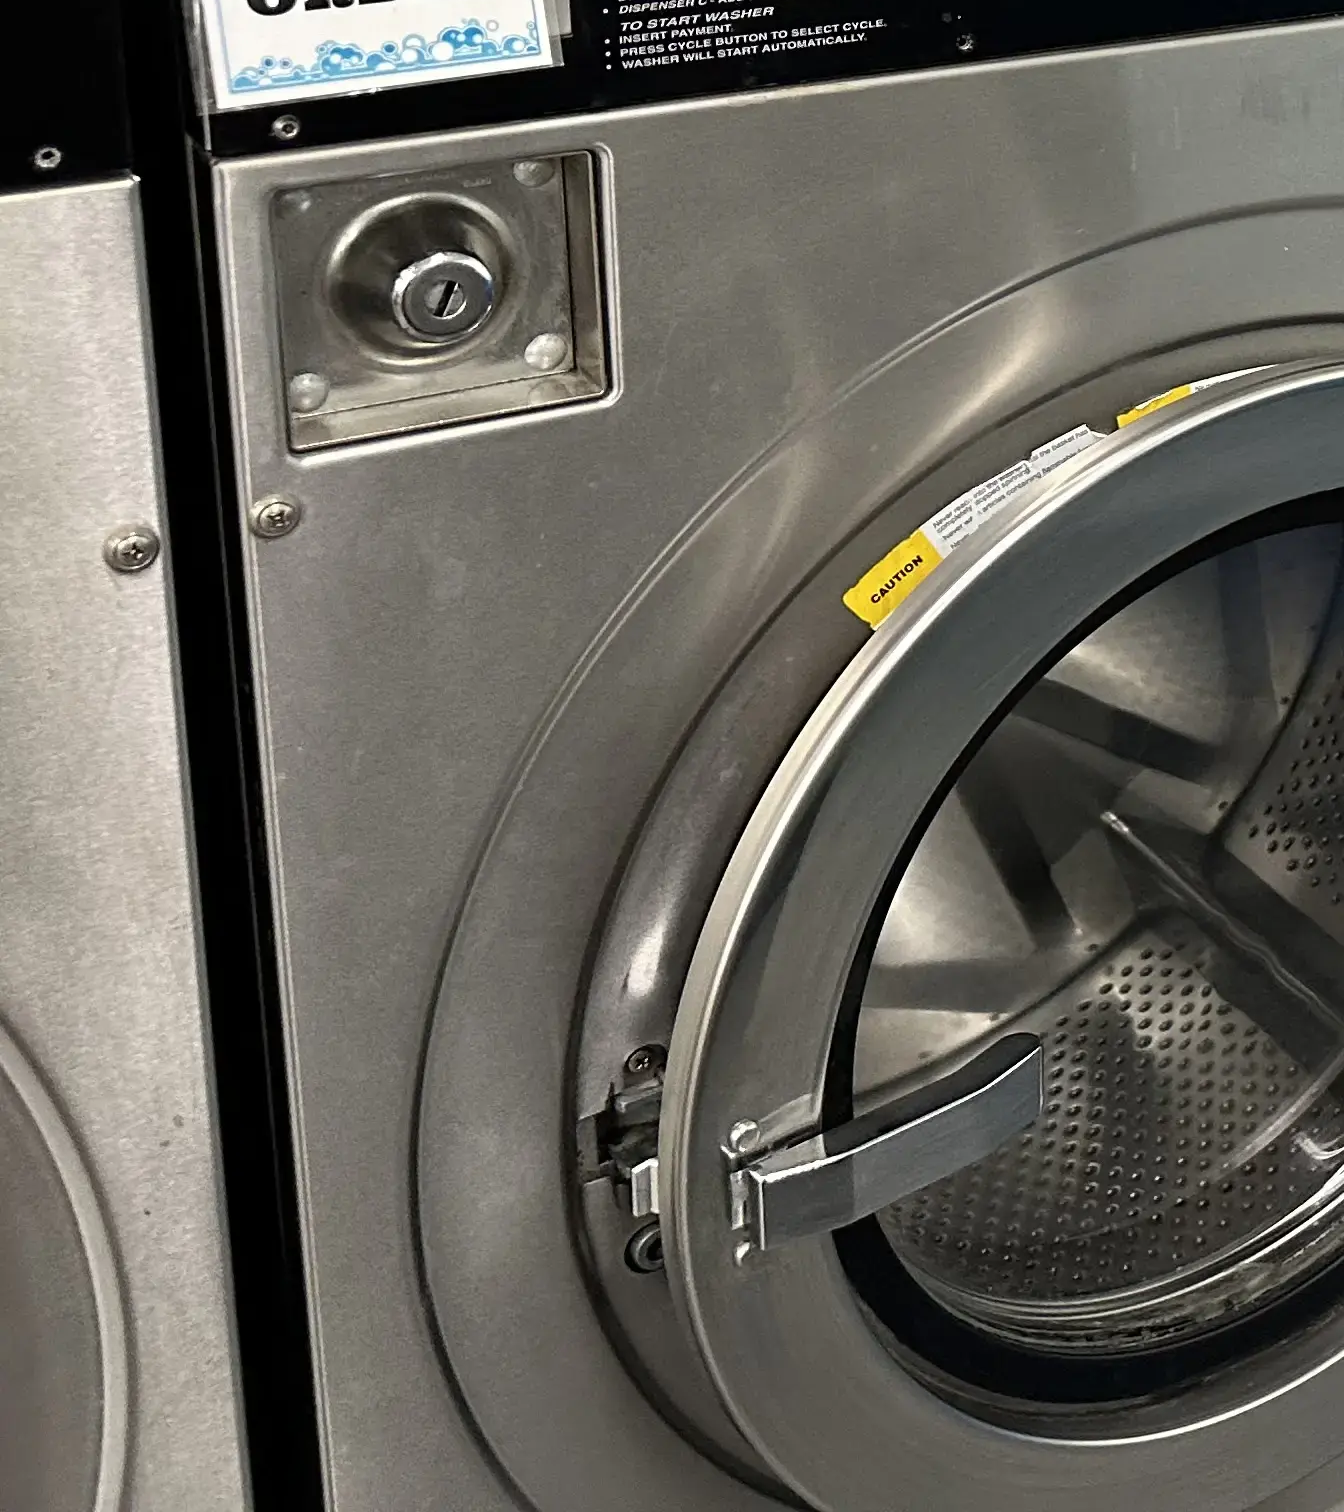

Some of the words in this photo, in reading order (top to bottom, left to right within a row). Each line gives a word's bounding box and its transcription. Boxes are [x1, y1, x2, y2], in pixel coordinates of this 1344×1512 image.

[621, 20, 642, 31] TO
[647, 14, 700, 28] START
[705, 7, 775, 22] WASHER
[619, 31, 667, 44] INSERT
[620, 43, 664, 57] PRESS
[668, 38, 712, 51] CYCLE
[716, 32, 767, 46] BUTTON
[771, 30, 787, 39] TO
[792, 24, 839, 37] SELECT
[843, 19, 887, 31] CYCLE.
[622, 54, 679, 69] WASHER
[683, 50, 714, 62] WILL
[718, 45, 758, 58] START
[762, 33, 867, 52] AUTOMATICALLY.
[871, 555, 924, 604] CAUTION
